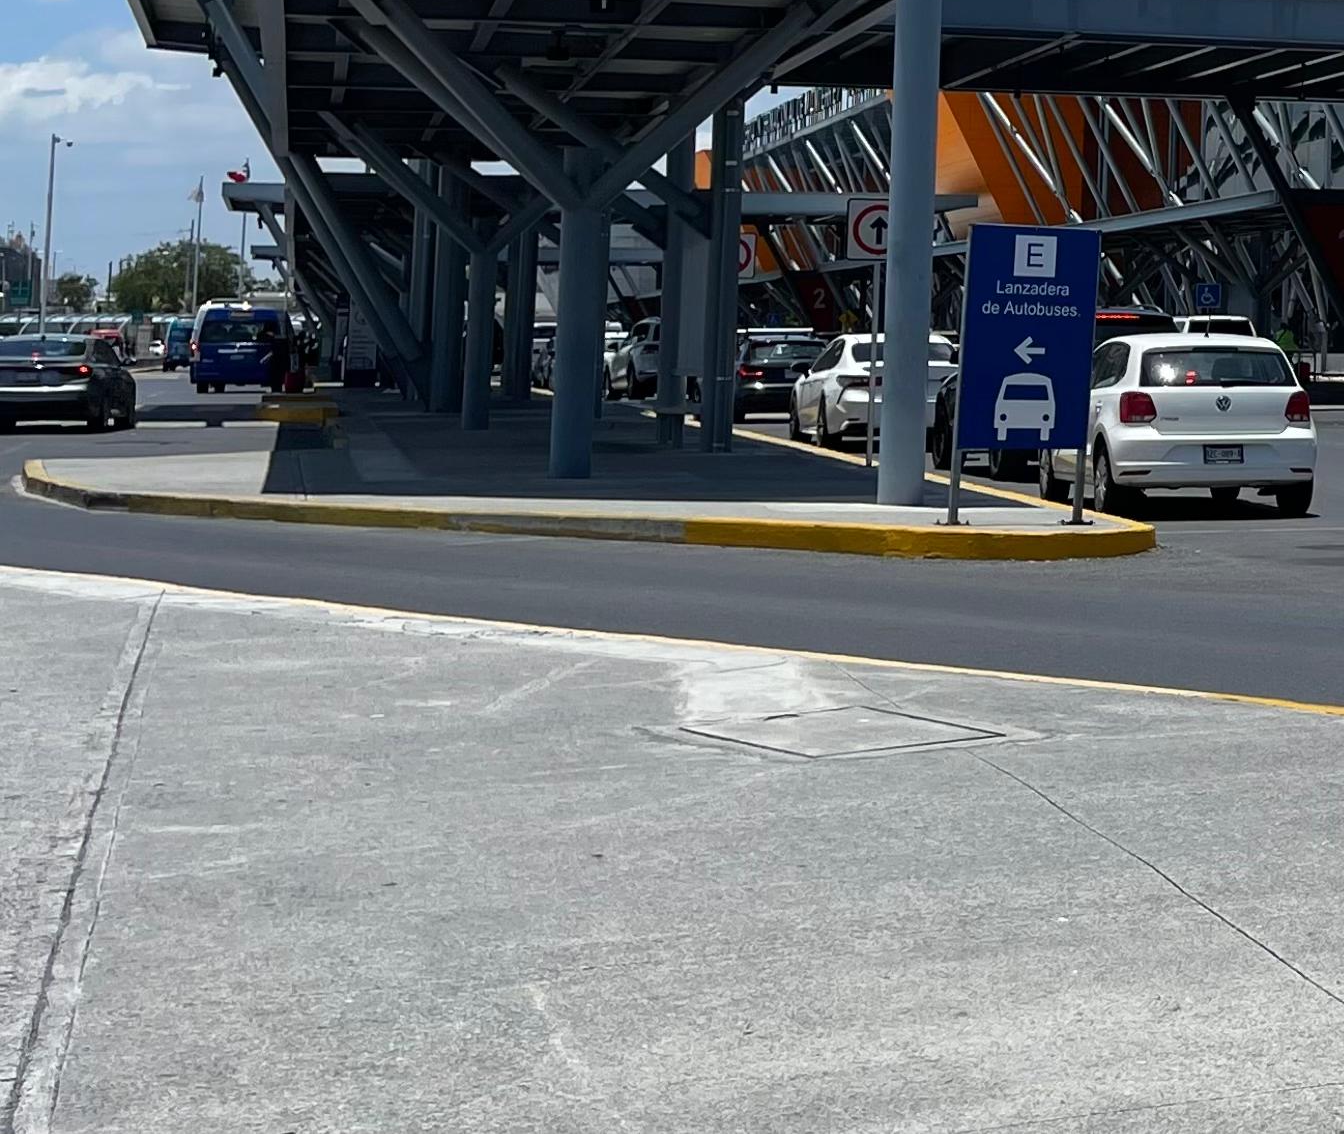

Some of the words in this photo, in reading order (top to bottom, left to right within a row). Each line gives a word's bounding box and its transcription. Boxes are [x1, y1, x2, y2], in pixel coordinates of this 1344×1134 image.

[1027, 243, 1044, 267] E
[996, 279, 1070, 296] Lanzadera
[813, 288, 826, 309] 2
[981, 300, 1000, 315] de
